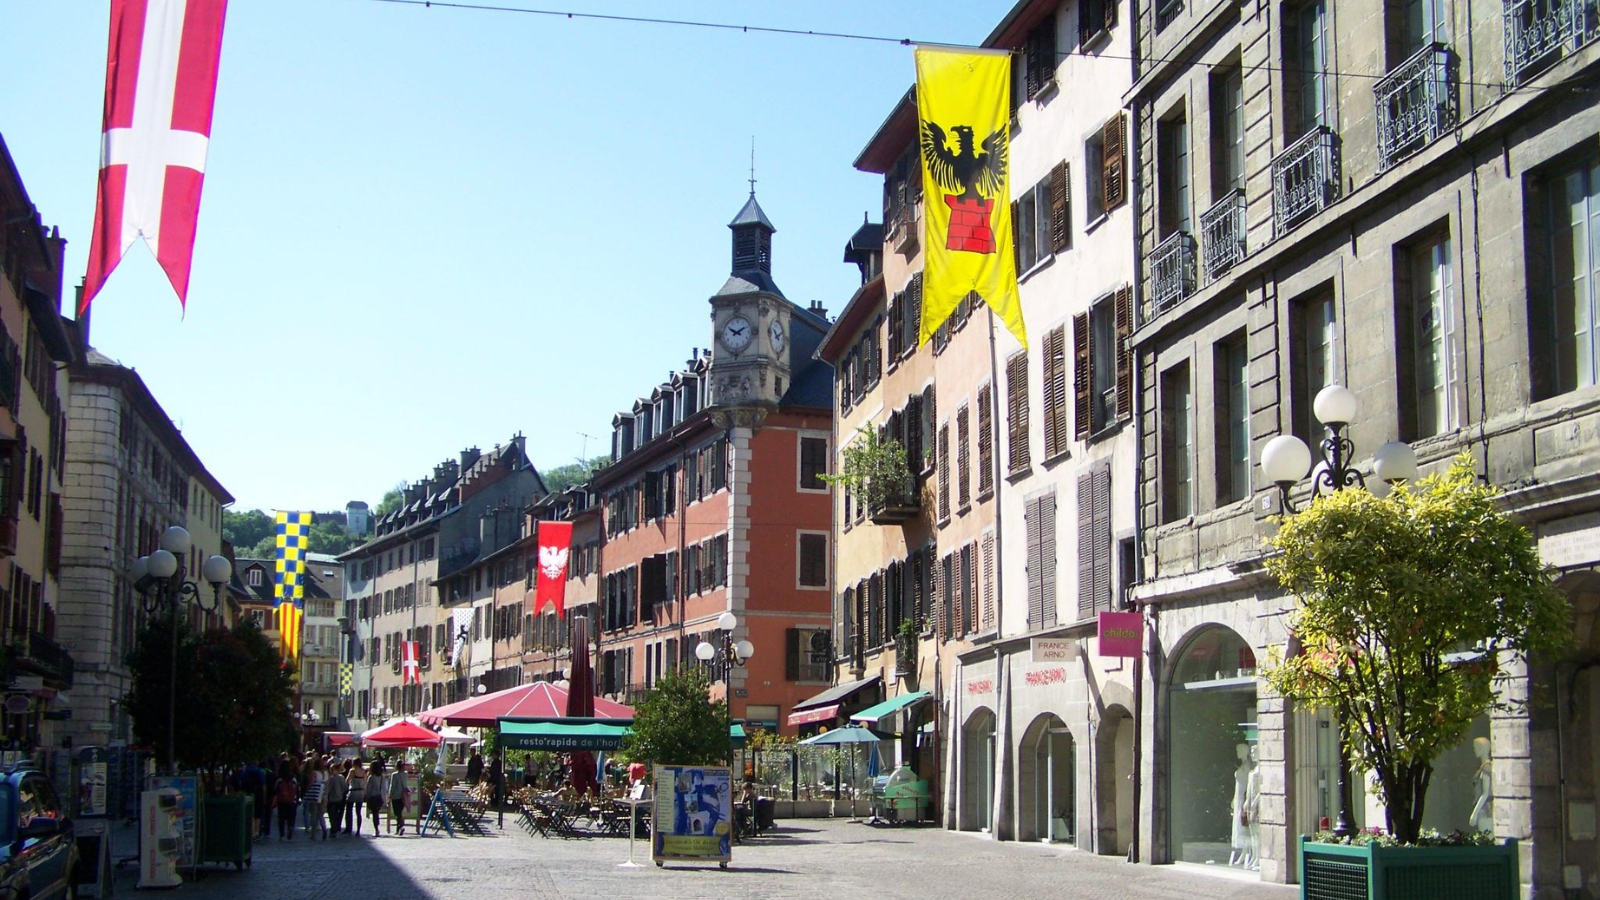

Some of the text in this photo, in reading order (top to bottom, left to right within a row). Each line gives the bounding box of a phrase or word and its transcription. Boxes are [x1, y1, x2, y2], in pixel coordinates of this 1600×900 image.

[1038, 642, 1070, 650] FRANCE
[519, 737, 577, 748] resto'rapide
[581, 738, 593, 747] de
